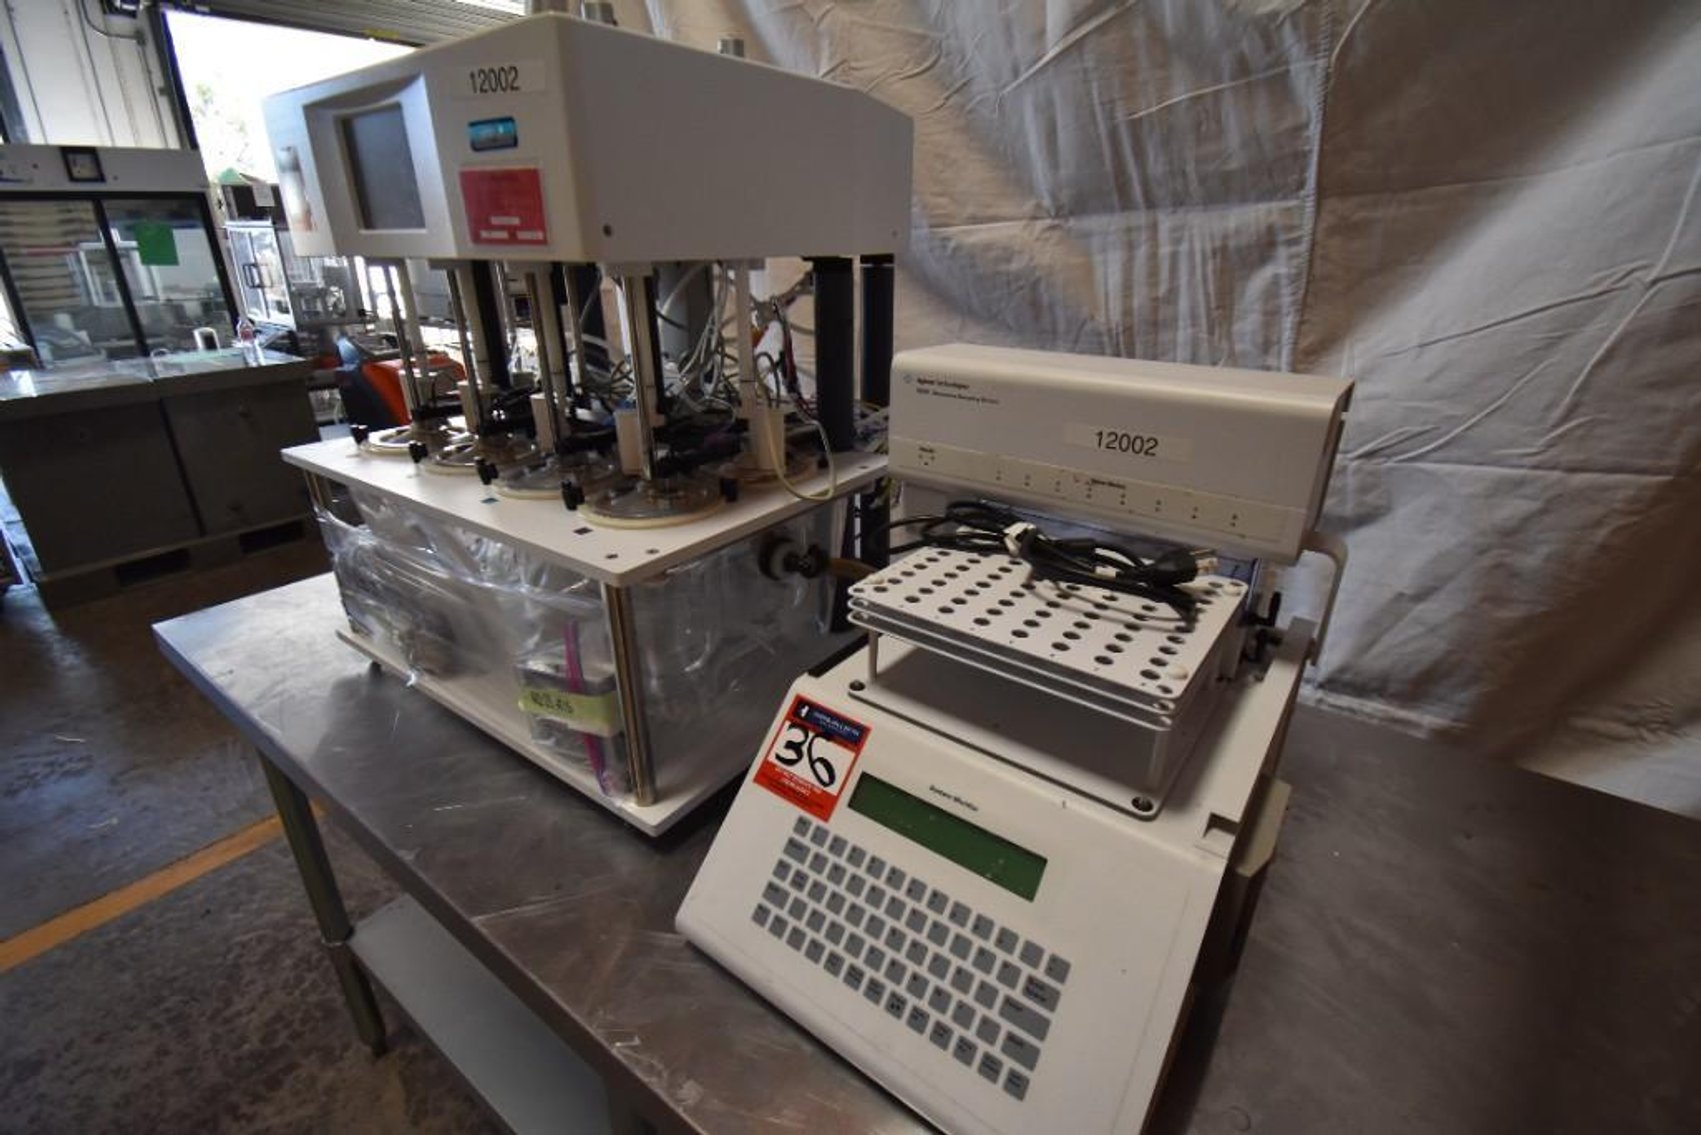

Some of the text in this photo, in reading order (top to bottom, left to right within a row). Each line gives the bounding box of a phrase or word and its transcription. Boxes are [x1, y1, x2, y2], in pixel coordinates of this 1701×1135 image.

[469, 66, 520, 94] 12002
[1094, 429, 1159, 457] 12002
[774, 723, 836, 788] 36
